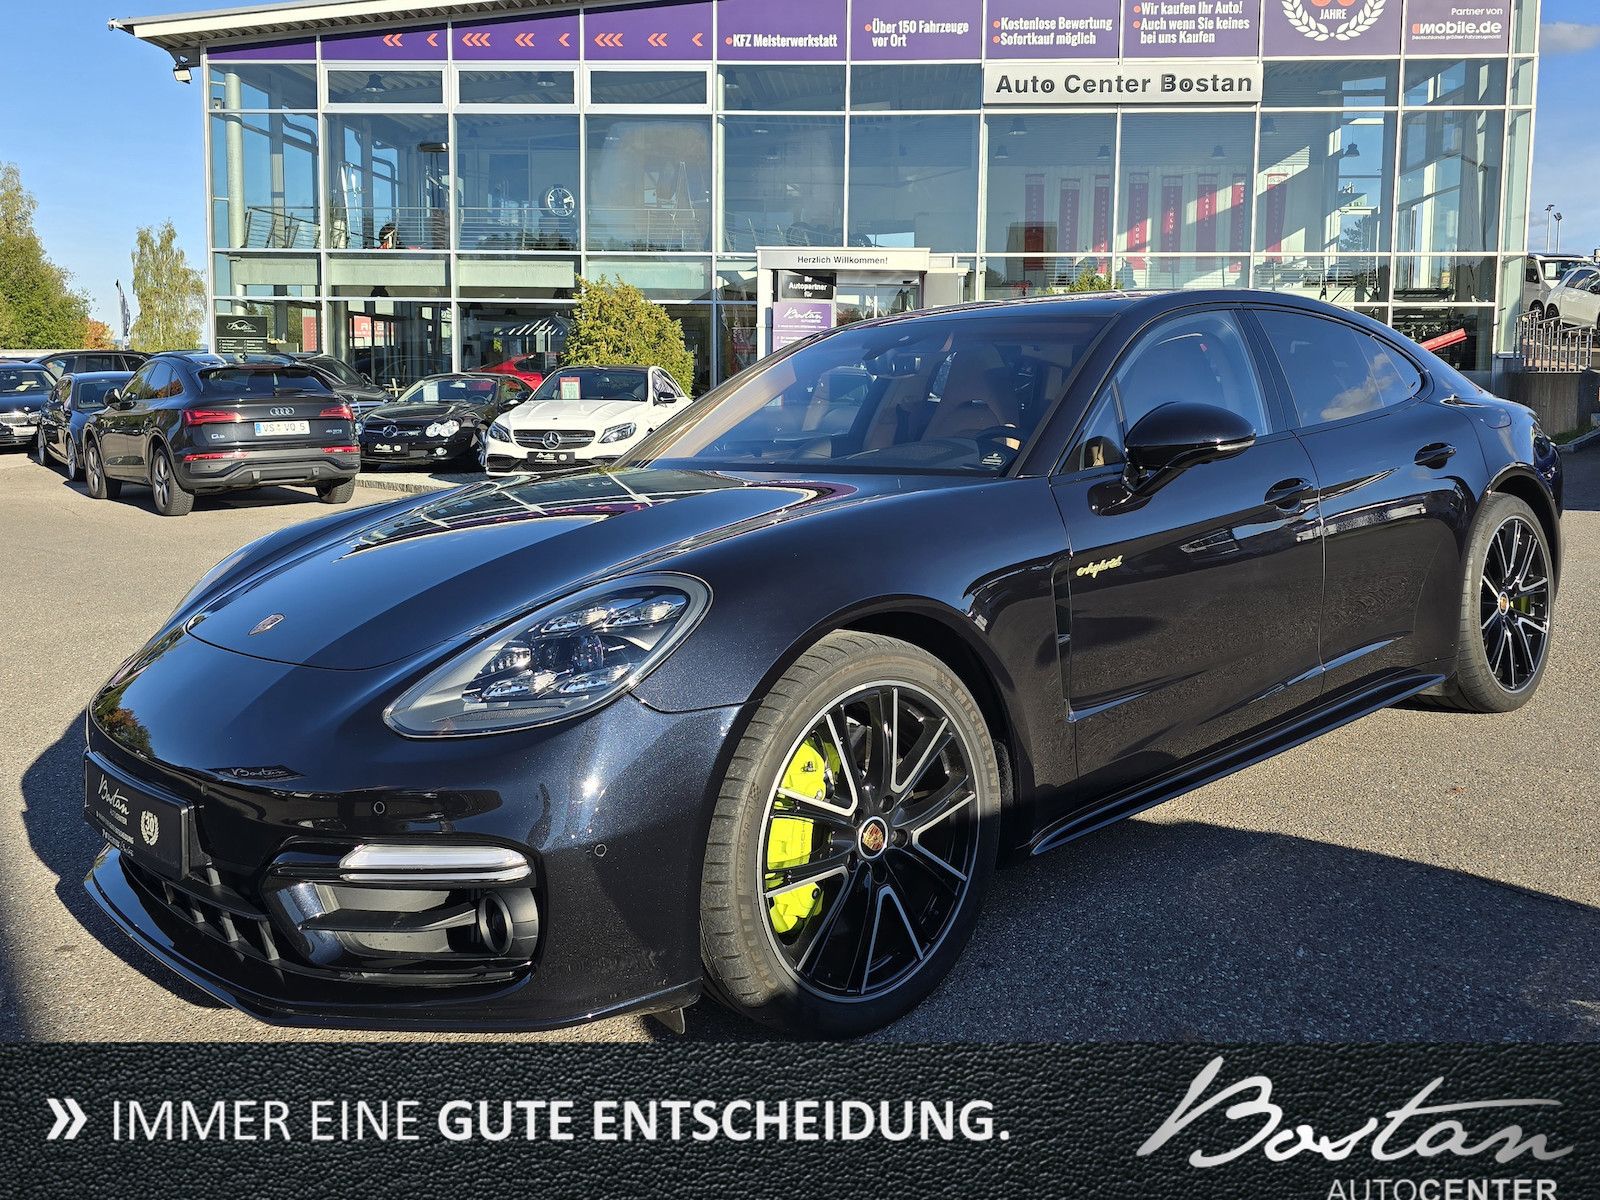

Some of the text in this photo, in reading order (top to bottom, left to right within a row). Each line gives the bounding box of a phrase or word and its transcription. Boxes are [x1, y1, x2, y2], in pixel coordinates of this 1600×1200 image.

[1141, 1, 1244, 15] Wir kaufen Ihr Auto!
[1319, 9, 1347, 19] JAHRE
[1451, 8, 1485, 16] Partner
[872, 18, 970, 35] Über 150 Fahrzeuge
[1001, 17, 1113, 32] Kostenlose Bewertung
[1140, 17, 1250, 31] Auch wenn Sie keines
[1416, 20, 1503, 35] mobile.de
[733, 33, 838, 48] KFZ Meisterwerkstatt
[872, 34, 907, 48] vor Ort
[1000, 31, 1097, 47] Sofortkauf möglich
[1140, 30, 1216, 44] bei uns Kaufen
[996, 74, 1253, 94] Auto Center Bostan
[797, 255, 888, 265] Herzlich Willkommen!
[788, 281, 828, 291] Autopartner
[263, 423, 275, 432] VS
